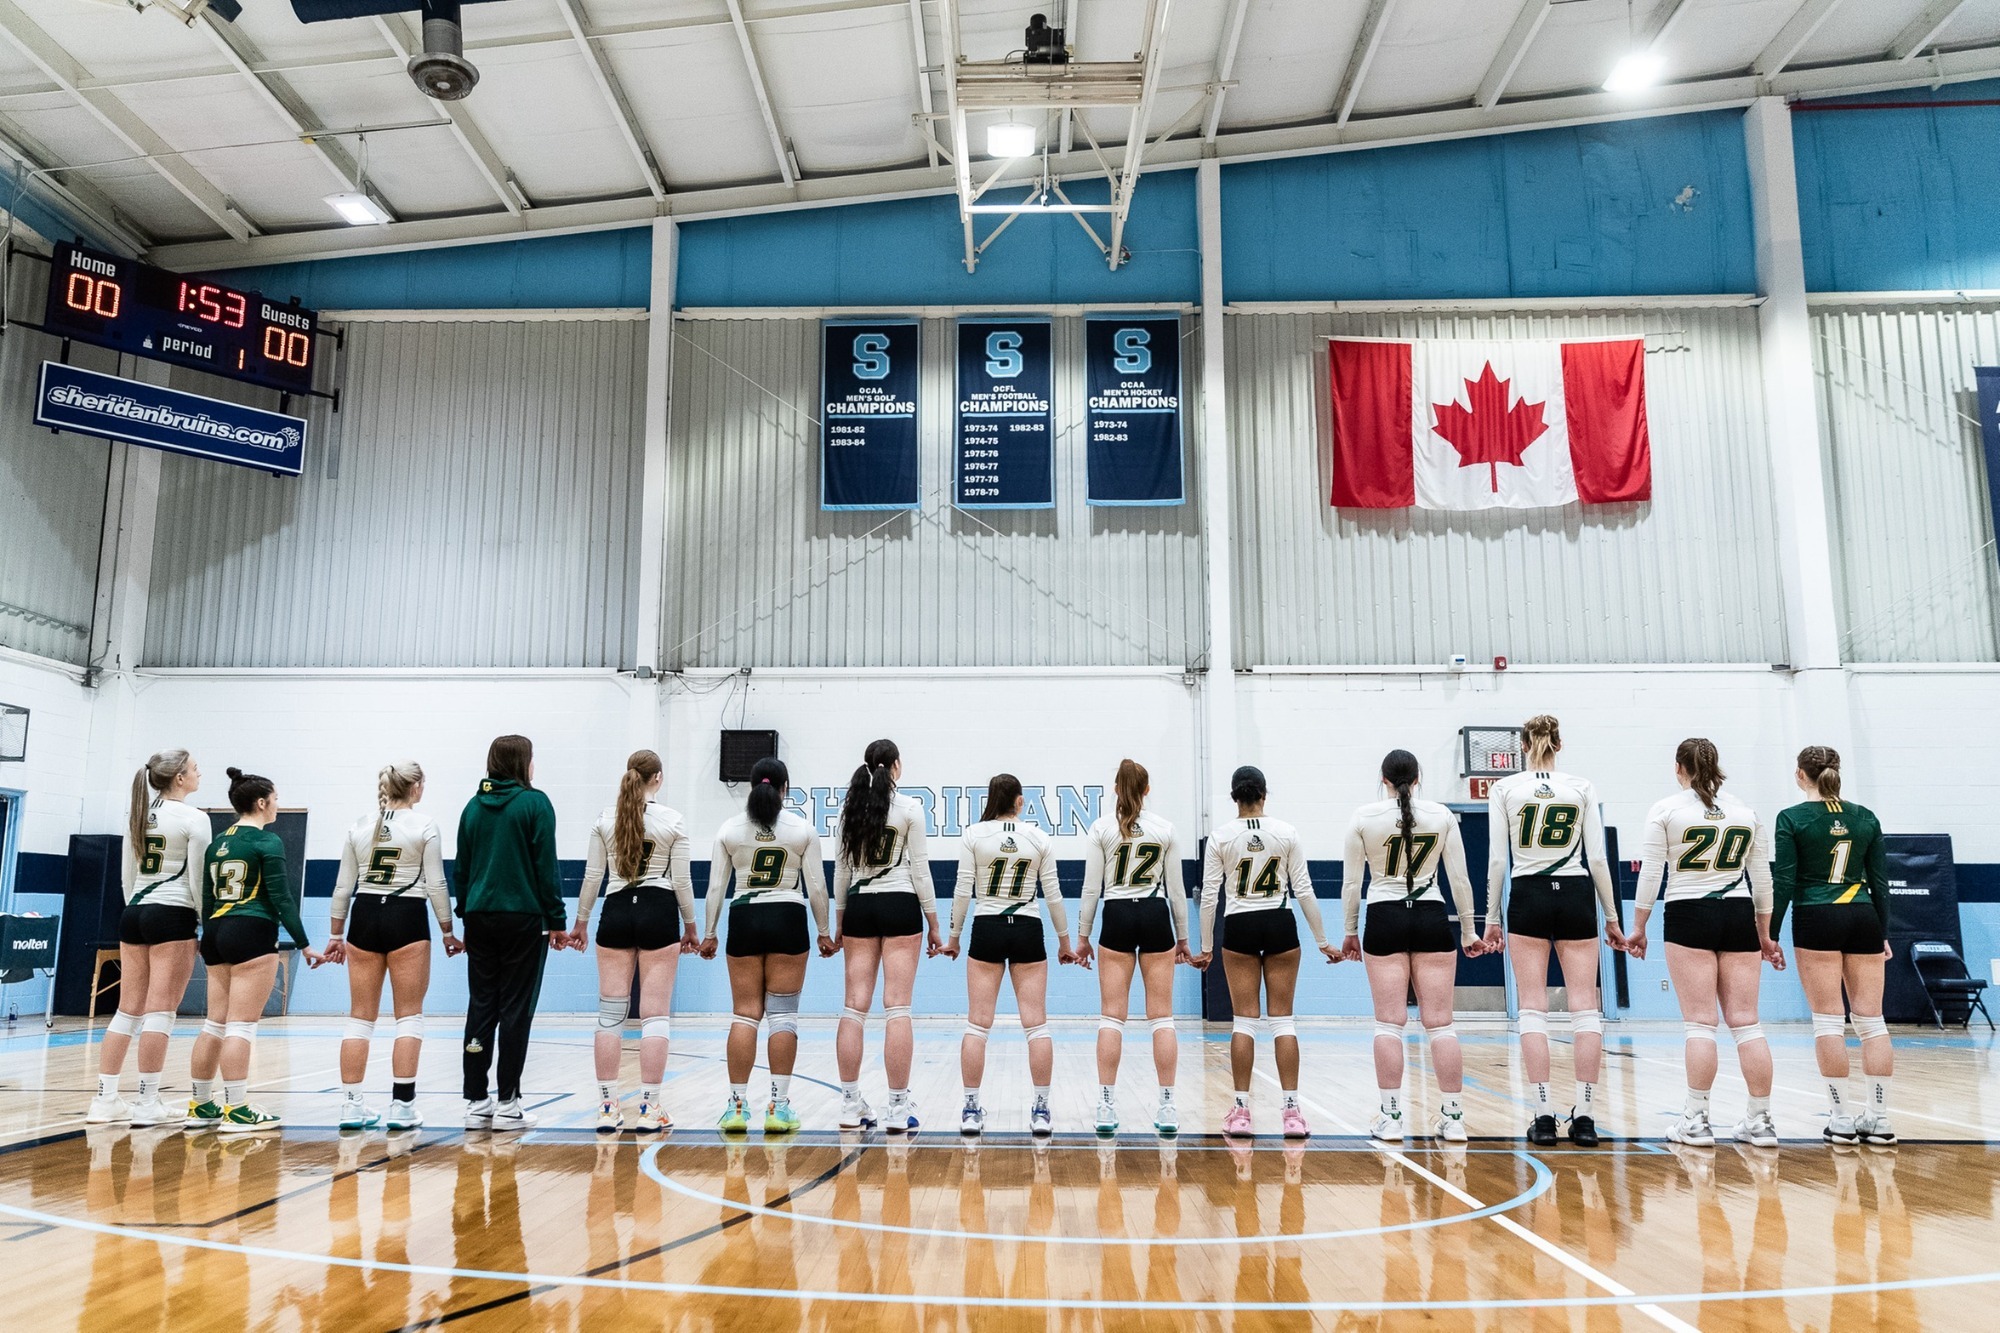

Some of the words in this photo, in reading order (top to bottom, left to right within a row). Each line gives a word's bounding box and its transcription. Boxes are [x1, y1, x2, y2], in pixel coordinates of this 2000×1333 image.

[70, 250, 116, 277] Home
[67, 273, 121, 318] 00
[178, 282, 246, 328] 1:53
[261, 303, 310, 331] Guests
[163, 336, 212, 359] period
[264, 326, 309, 367] 00
[853, 333, 890, 379] S
[985, 331, 1023, 378] S
[1114, 328, 1152, 375] S
[238, 349, 244, 370] 1
[993, 385, 1016, 393] OCFL
[826, 402, 916, 414] CHAMPIONS
[960, 400, 1049, 412] CHAMPIONS
[1089, 396, 1178, 408] CHAMPIONS
[49, 385, 286, 450] sheridanbruins.com
[964, 424, 998, 432] 1973-74
[1009, 423, 1045, 432] 1982-83
[1094, 420, 1128, 429] 1973-74
[830, 426, 866, 434] 1981-82
[1093, 434, 1128, 442] 1982-83
[830, 438, 866, 446] 1983-84
[964, 437, 999, 445] 1974-75
[964, 450, 999, 458] 1975-76
[964, 462, 999, 470] 1976-77
[964, 475, 999, 483] 1977-78
[964, 488, 999, 496] 1978-79
[1491, 753, 1517, 769] EXIT
[1517, 803, 1580, 848] 18
[140, 834, 167, 875] 6
[1382, 833, 1439, 878] 17
[1677, 825, 1753, 872] 20
[364, 847, 402, 885] 5
[747, 846, 788, 888] 9
[1113, 842, 1162, 887] 12
[1828, 840, 1852, 884] 1
[986, 857, 1032, 898] 11
[1235, 856, 1281, 898] 14
[1551, 882, 1560, 890] 18
[1405, 900, 1413, 908] 17
[1007, 916, 1014, 924] 11
[12, 939, 48, 950] molten
[771, 1081, 779, 1098] LOR
